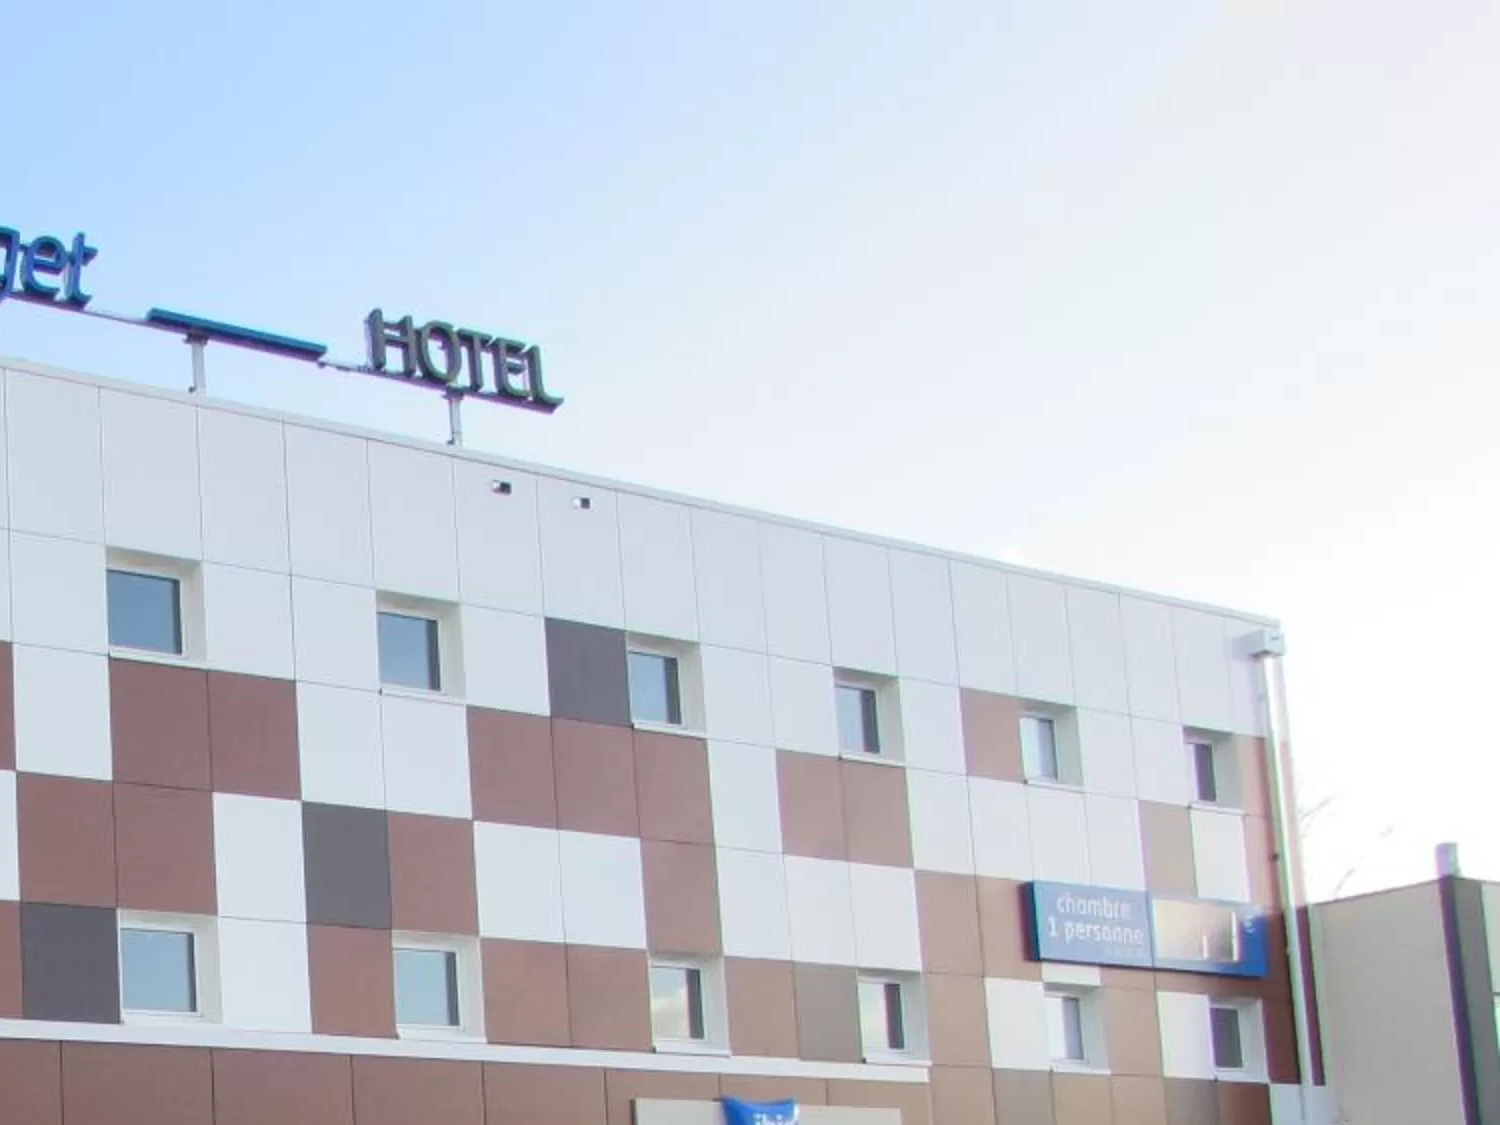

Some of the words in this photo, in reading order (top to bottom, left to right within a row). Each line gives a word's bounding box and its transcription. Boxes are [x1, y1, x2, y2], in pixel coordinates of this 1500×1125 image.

[364, 308, 564, 410] HOTEL
[1056, 891, 1133, 919] chambre
[1047, 915, 1058, 938] 1
[1063, 920, 1146, 946] personne
